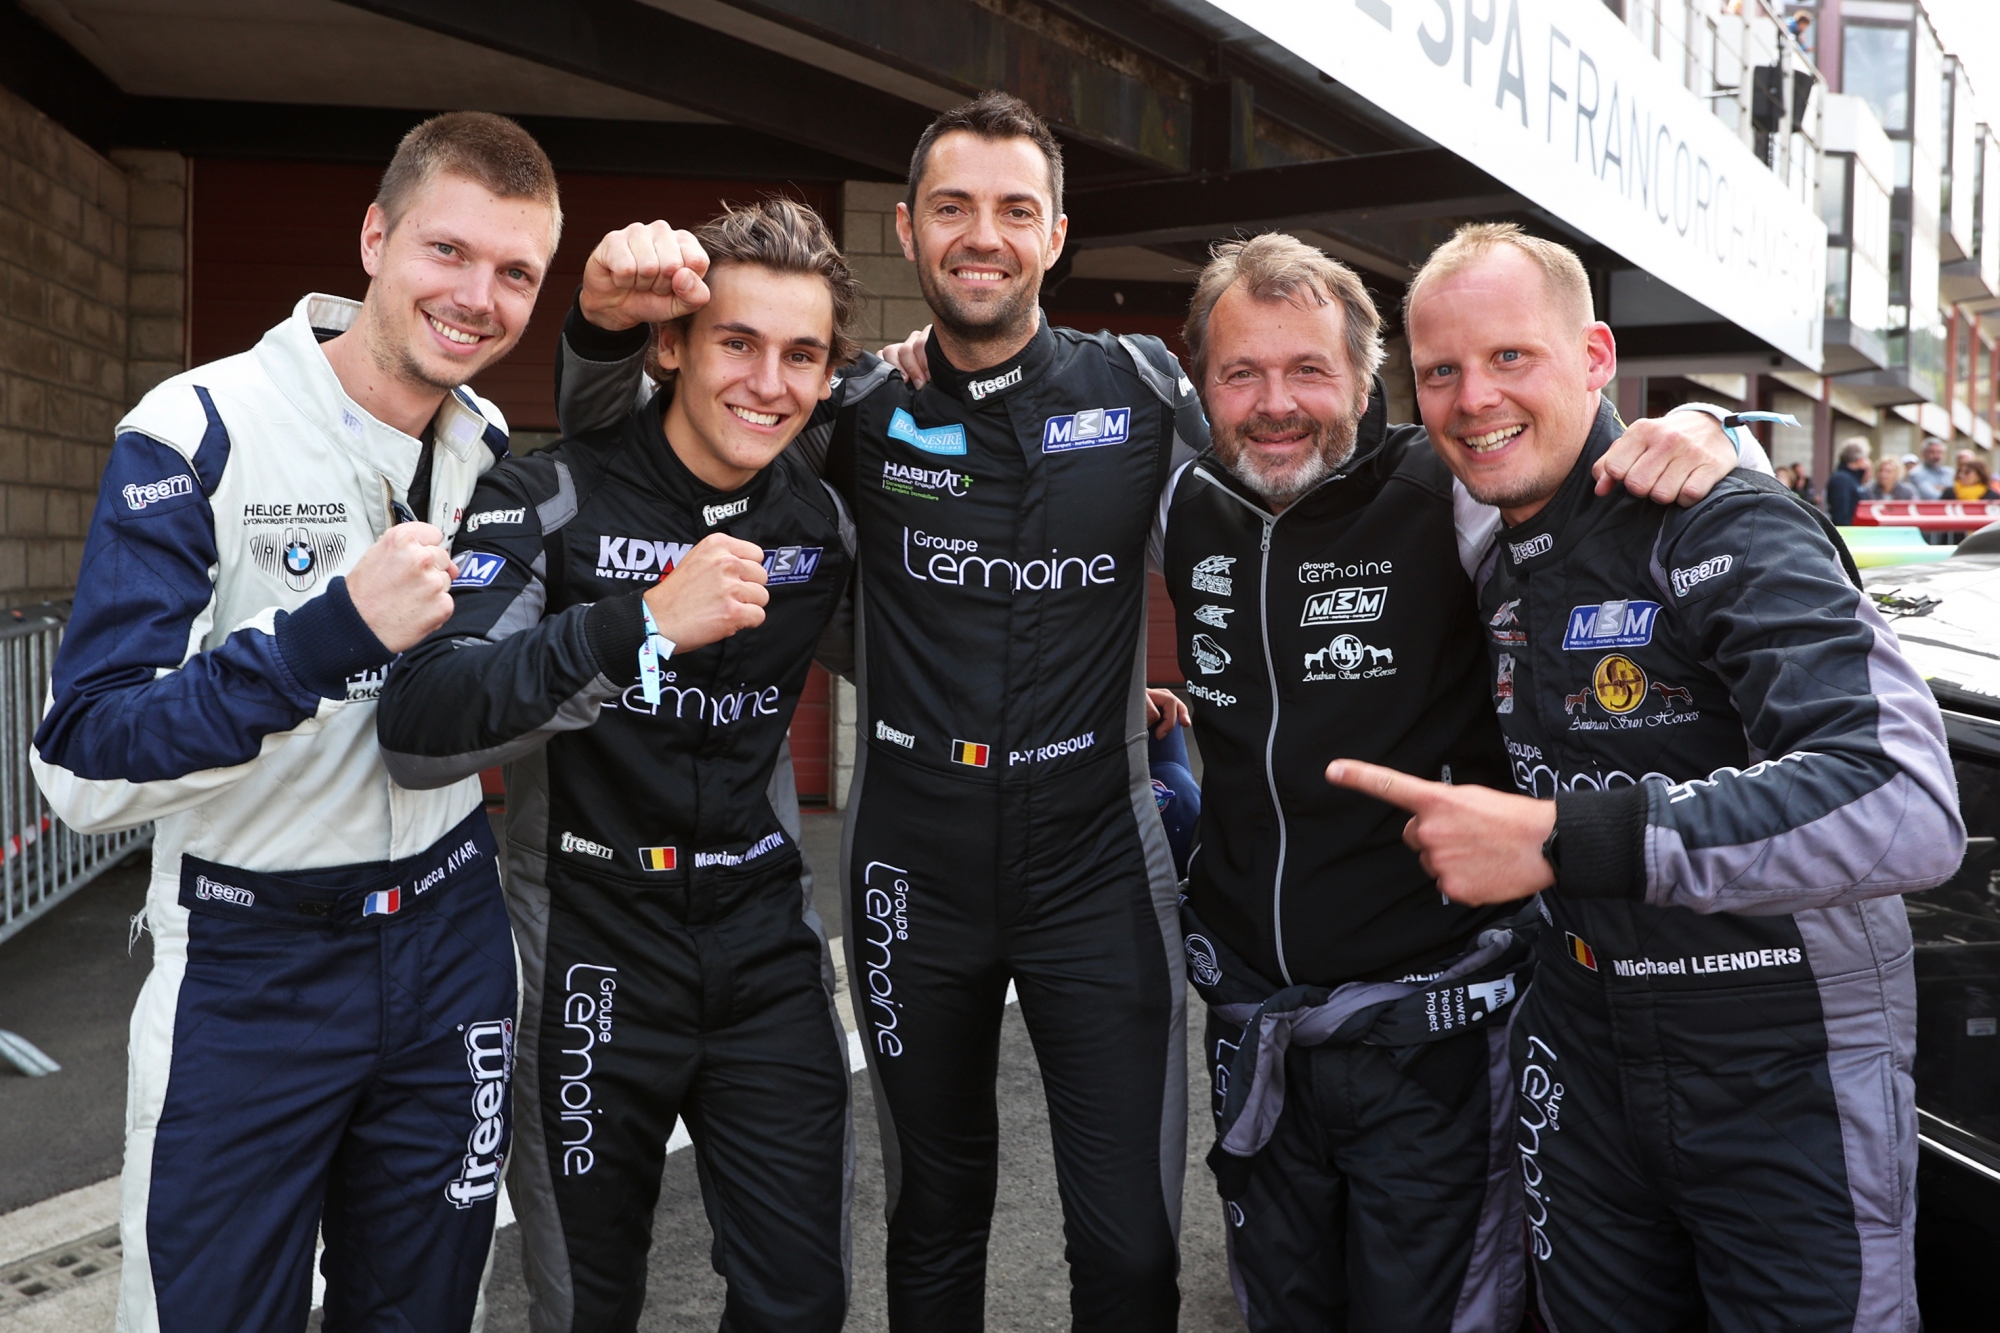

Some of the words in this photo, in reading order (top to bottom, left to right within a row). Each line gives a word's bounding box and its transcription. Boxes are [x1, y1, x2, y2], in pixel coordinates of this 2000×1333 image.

[969, 367, 1021, 398] freem
[123, 476, 192, 509] freem
[297, 503, 346, 516] MOTOS
[467, 507, 526, 531] freem
[703, 498, 748, 525] freem
[914, 531, 978, 554] Groupe
[1510, 535, 1551, 562] freem
[595, 567, 668, 582] MOTO
[904, 526, 1116, 594] Lemoine
[1299, 560, 1392, 583] Lemoine
[1302, 562, 1335, 573] Groupe
[1673, 556, 1732, 595] freem
[601, 683, 780, 727] emoine
[876, 720, 915, 749] freem
[1036, 731, 1095, 763] ROSOUX
[561, 831, 614, 860] freem
[744, 831, 785, 863] MARTIN
[413, 867, 446, 896] Lucca
[446, 839, 479, 874] AYARI
[196, 875, 254, 906] freem
[894, 879, 909, 941] Groupe
[864, 860, 907, 1058] Lemoine
[1612, 957, 1687, 978] Michael
[1690, 947, 1802, 975] LEENDERS
[598, 977, 617, 1044] Groupe
[1425, 991, 1440, 1033] Project
[1440, 989, 1454, 1030] People
[1454, 986, 1466, 1026] Power
[559, 963, 617, 1176] Lemoine
[448, 1025, 504, 1205] freem
[1517, 1035, 1558, 1261] Lemoine
